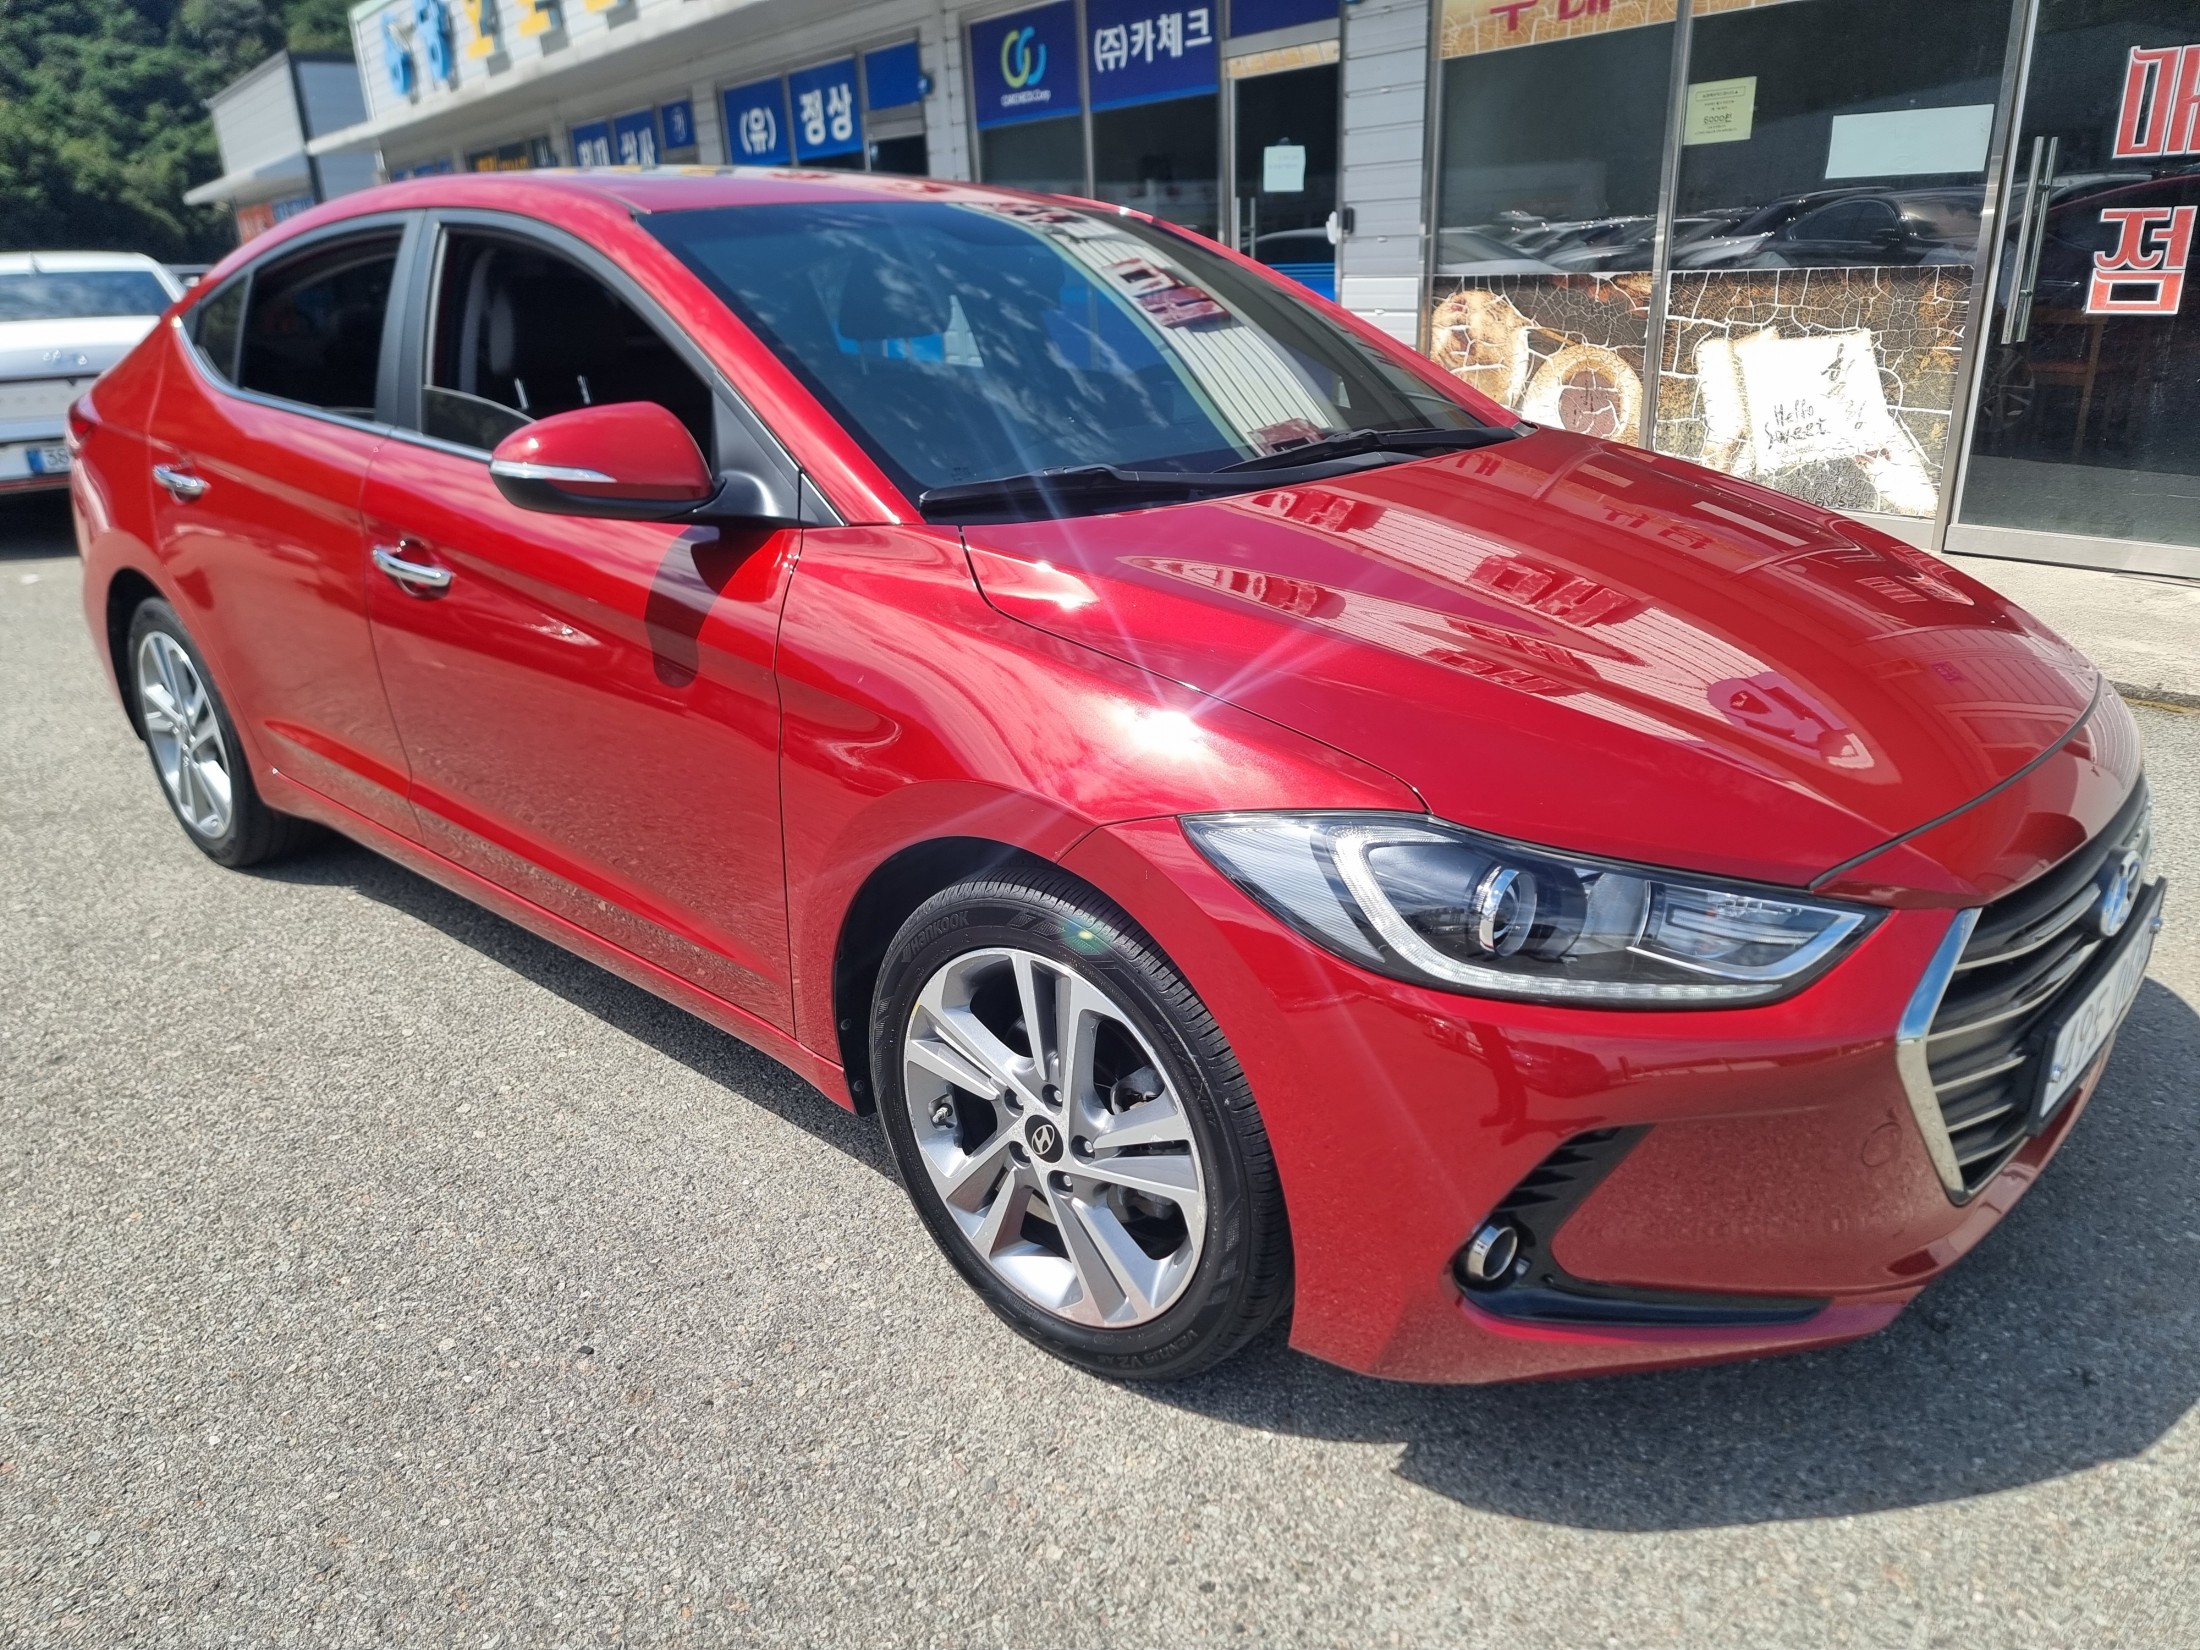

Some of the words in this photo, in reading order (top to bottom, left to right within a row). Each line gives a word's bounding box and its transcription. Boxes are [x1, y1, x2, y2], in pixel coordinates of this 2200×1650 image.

[1094, 7, 1213, 73] (주)카체크
[740, 105, 777, 155] (유)
[1772, 399, 1814, 427] Hello
